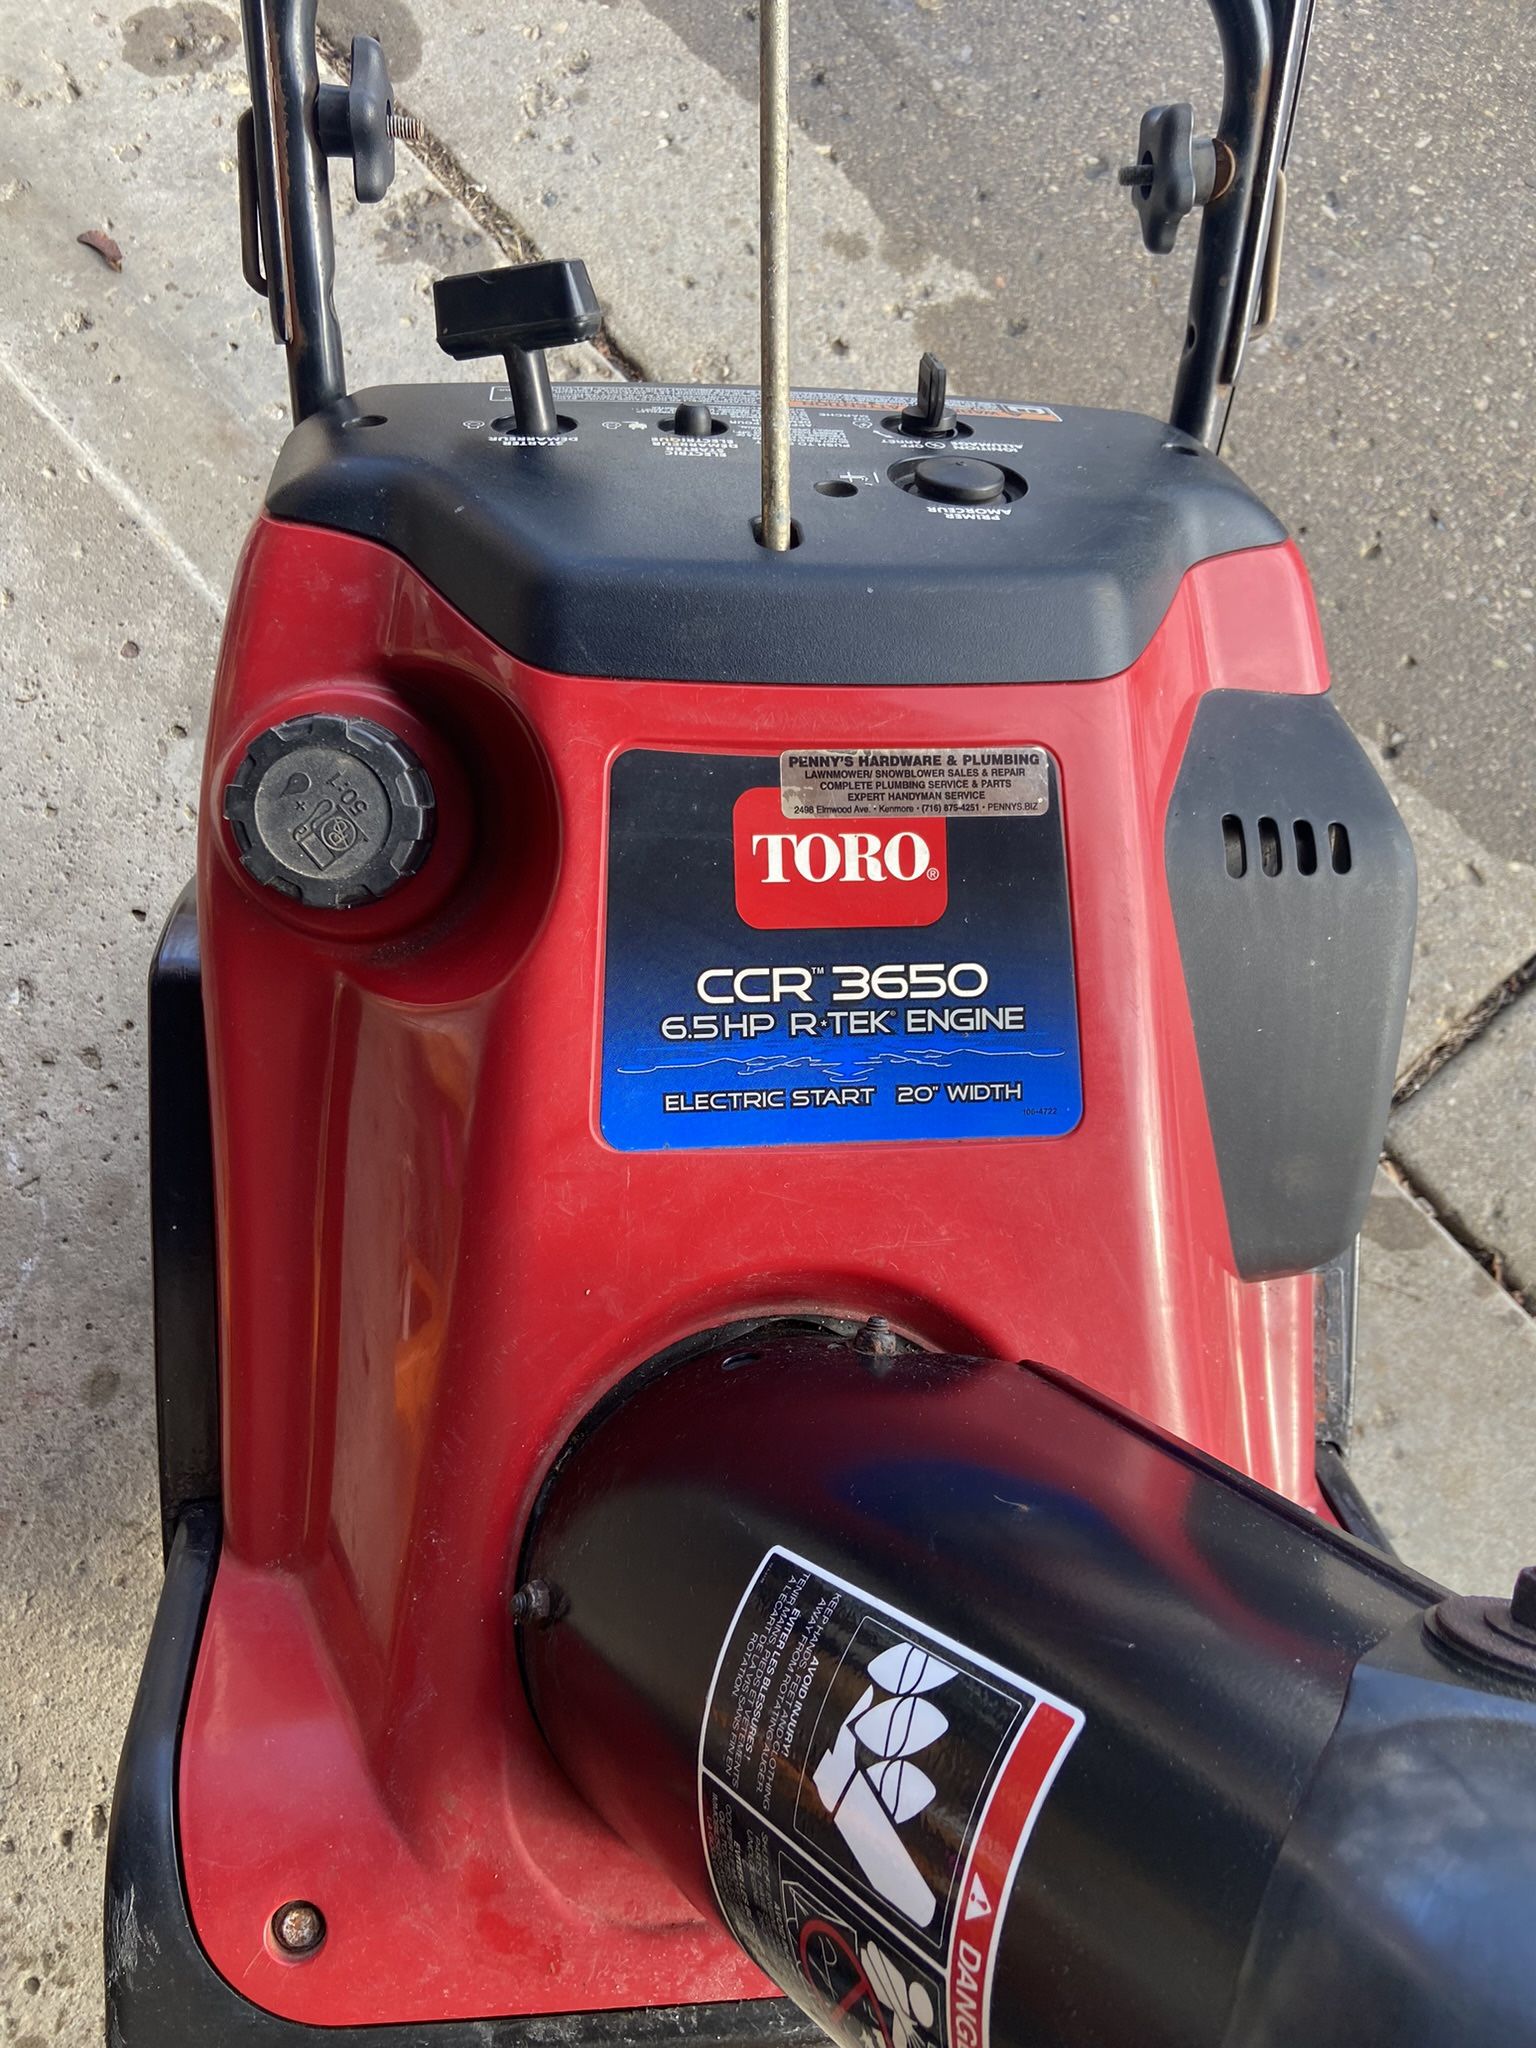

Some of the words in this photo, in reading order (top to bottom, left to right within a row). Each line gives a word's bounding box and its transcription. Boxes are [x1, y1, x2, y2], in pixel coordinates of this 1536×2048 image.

[926, 507, 1012, 515] AMORCEUR
[789, 756, 853, 768] PENNY'S
[858, 755, 942, 767] HARDWARE
[947, 755, 957, 766] &
[963, 754, 1040, 766] PLUMBING
[805, 770, 873, 779] LAWNMOWER/
[875, 768, 945, 778] SNOWBLOWER
[948, 768, 979, 777] SALES
[982, 768, 988, 777] &
[991, 768, 1025, 776] REPAIR
[820, 781, 873, 790] COMPLETE
[876, 780, 925, 790] PLUMBING
[928, 780, 968, 789] SERVICE
[972, 780, 978, 788] &
[981, 779, 1011, 788] PARTS
[848, 793, 885, 801] EXPERT
[888, 792, 941, 800] HANDYMAN
[945, 791, 985, 799] SERVICE
[794, 806, 814, 814] 2498
[816, 805, 852, 814] Elmwood
[879, 804, 914, 813] Kenmore
[921, 804, 942, 813] (716)
[944, 803, 979, 812] 875-4251
[987, 802, 1038, 812] PENNYS.BIZ
[832, 963, 988, 1001] 3650
[907, 1007, 1024, 1032] ENGINE
[665, 1091, 784, 1111] ELECTRIC
[792, 1088, 875, 1106] START
[898, 1086, 938, 1103] 20"
[947, 1083, 1021, 1101] WIDTH
[790, 1573, 811, 1606] TENIR
[805, 1597, 827, 1634] AWAY
[822, 1592, 842, 1625] KEEP
[756, 1634, 767, 1653] DE
[787, 1634, 808, 1673] FROM
[749, 1653, 760, 1670] LA
[752, 1649, 771, 1688] PIEDS
[766, 1650, 781, 1676] LES
[741, 1673, 753, 1692] VIS
[785, 1674, 802, 1709] FEET
[798, 1656, 820, 1699] AVOID
[747, 1688, 758, 1707] ET
[766, 1673, 792, 1741] ROTATING
[732, 1696, 746, 1731] SANS
[745, 1676, 771, 1754] BLESSURES
[776, 1709, 789, 1738] AND
[728, 1732, 738, 1754] FIN
[781, 1701, 803, 1757] INJURY!
[725, 1755, 733, 1776] EN
[762, 1740, 780, 1811] CLOTHING
